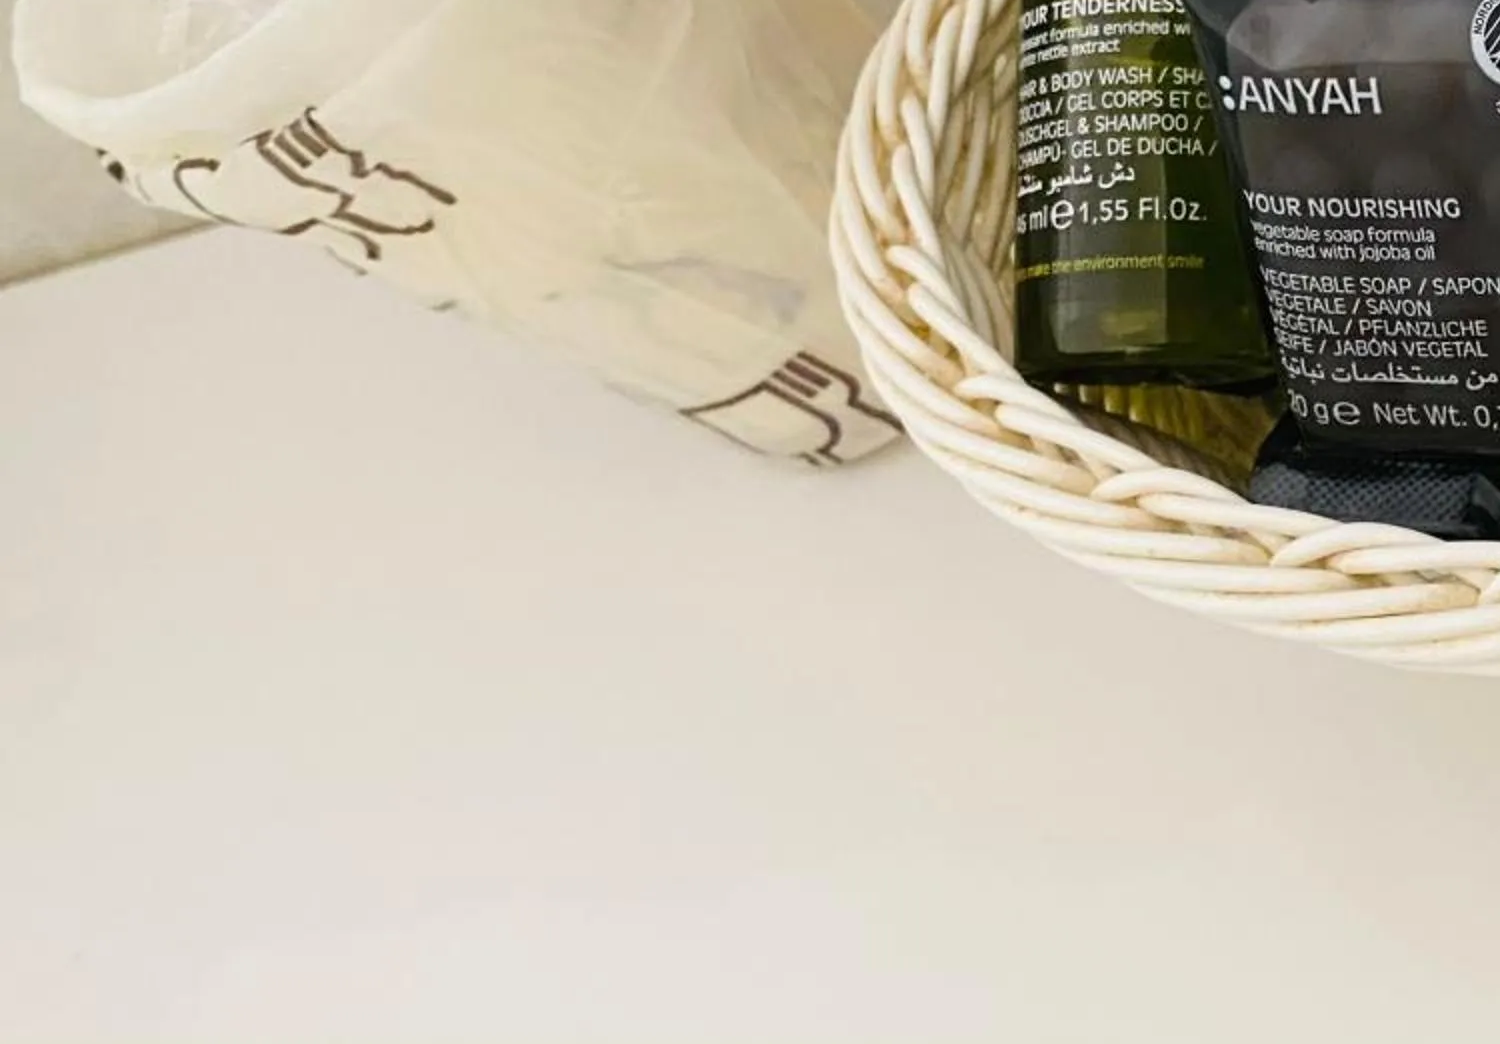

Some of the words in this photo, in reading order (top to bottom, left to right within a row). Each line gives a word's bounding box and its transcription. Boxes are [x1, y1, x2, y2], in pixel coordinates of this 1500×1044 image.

[1103, 20, 1169, 37] enriched
[1051, 69, 1094, 92] BODY
[1098, 67, 1152, 85] WASH
[1157, 66, 1168, 84] /
[1054, 96, 1065, 114] /
[1067, 92, 1097, 113] GEL
[1101, 91, 1163, 109] CORPS
[1169, 91, 1191, 108] ET
[1077, 117, 1090, 135] &
[1095, 114, 1189, 133] SHAMPOO
[1194, 115, 1203, 132] /
[1071, 140, 1101, 159] GEL
[1106, 137, 1132, 156] DE
[1137, 136, 1204, 156] DUCHA
[1208, 141, 1218, 156] /
[1079, 199, 1128, 226] 1,55
[1242, 188, 1302, 217] YOUR
[1307, 197, 1461, 218] NOURISHING
[1323, 228, 1364, 244] soap
[1367, 226, 1436, 243] formula
[1319, 243, 1356, 259] with
[1359, 243, 1411, 262] jojoba
[1414, 244, 1436, 261] oil
[1259, 264, 1356, 294] VEGETABLE
[1360, 277, 1411, 295] SOAP
[1417, 276, 1428, 295] /
[1264, 285, 1347, 315] VEGETALE
[1352, 297, 1361, 315] /
[1366, 299, 1432, 317] SAVON
[1344, 319, 1352, 335] /
[1359, 319, 1488, 338] PFLANZLICHE
[1319, 339, 1327, 355] /
[1401, 339, 1489, 357] VEGETAL
[1332, 362, 1459, 385] مستخلصات
[1465, 371, 1499, 392] من
[1313, 402, 1329, 425] g
[1373, 401, 1421, 425] Net
[1424, 403, 1467, 427] Wt.
